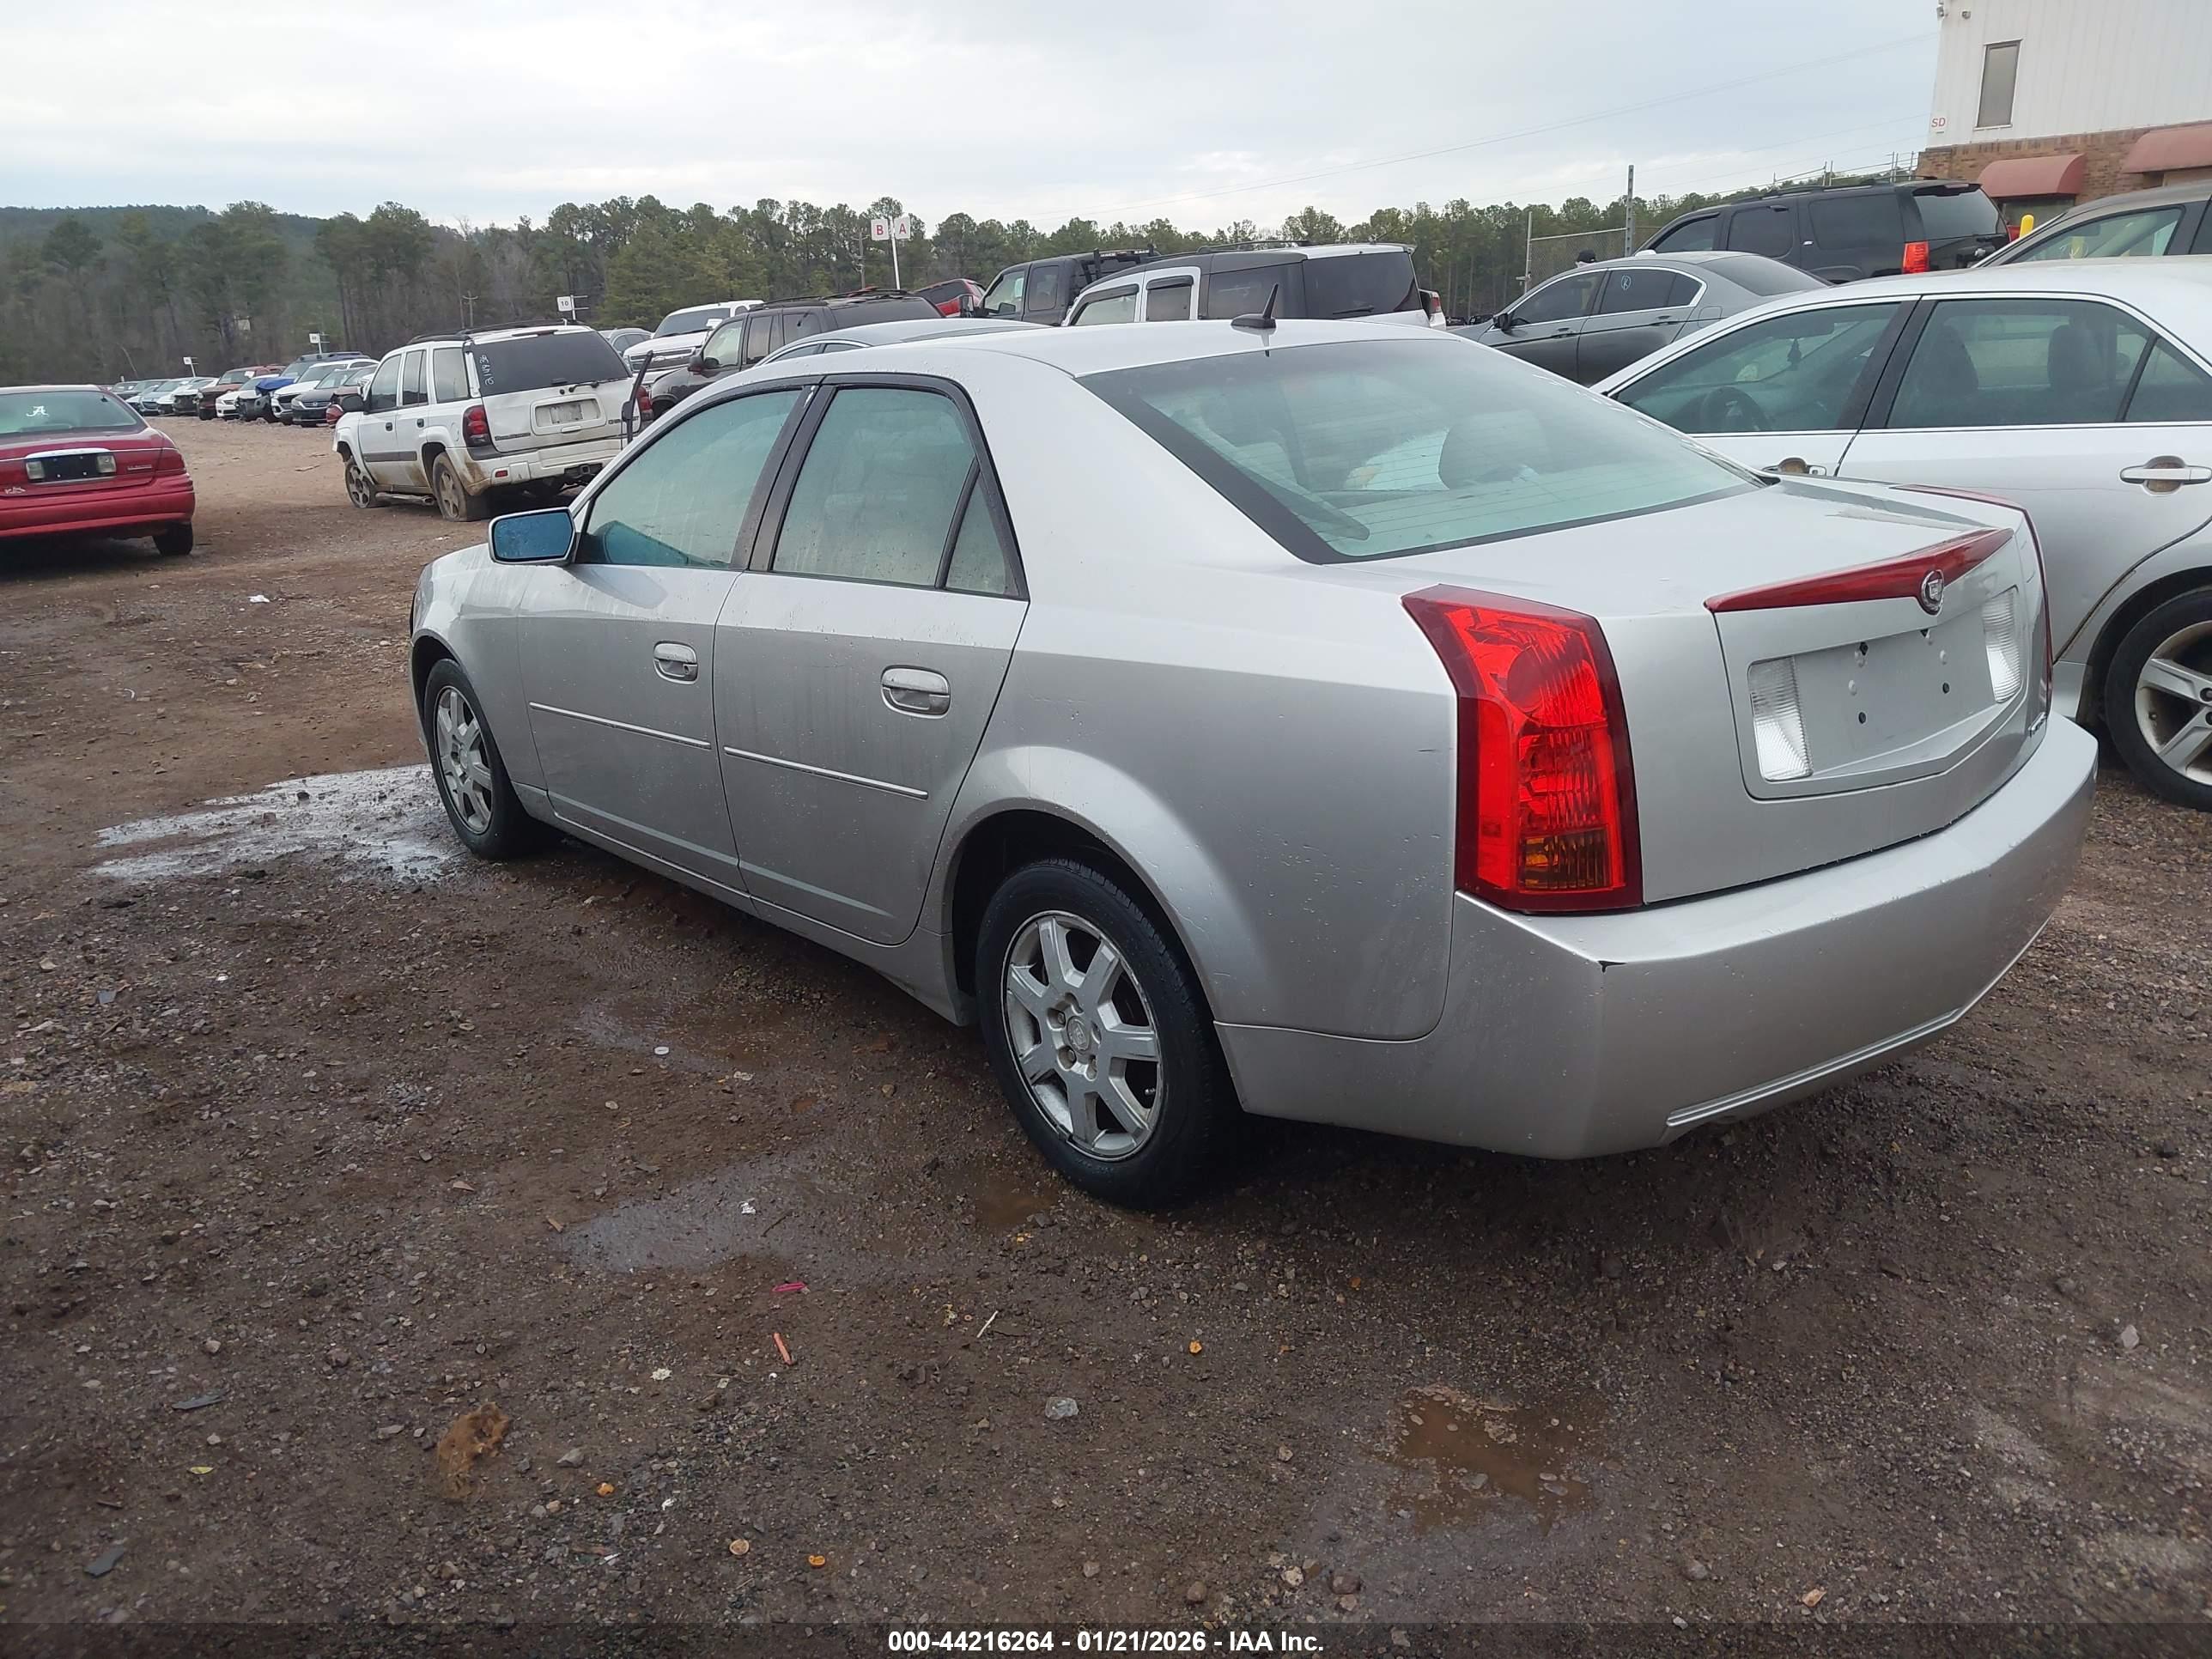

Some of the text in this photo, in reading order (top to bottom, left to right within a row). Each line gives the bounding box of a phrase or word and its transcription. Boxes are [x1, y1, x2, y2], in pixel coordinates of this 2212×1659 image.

[1931, 117, 1946, 128] SD
[876, 224, 884, 235] B
[899, 223, 907, 234] A
